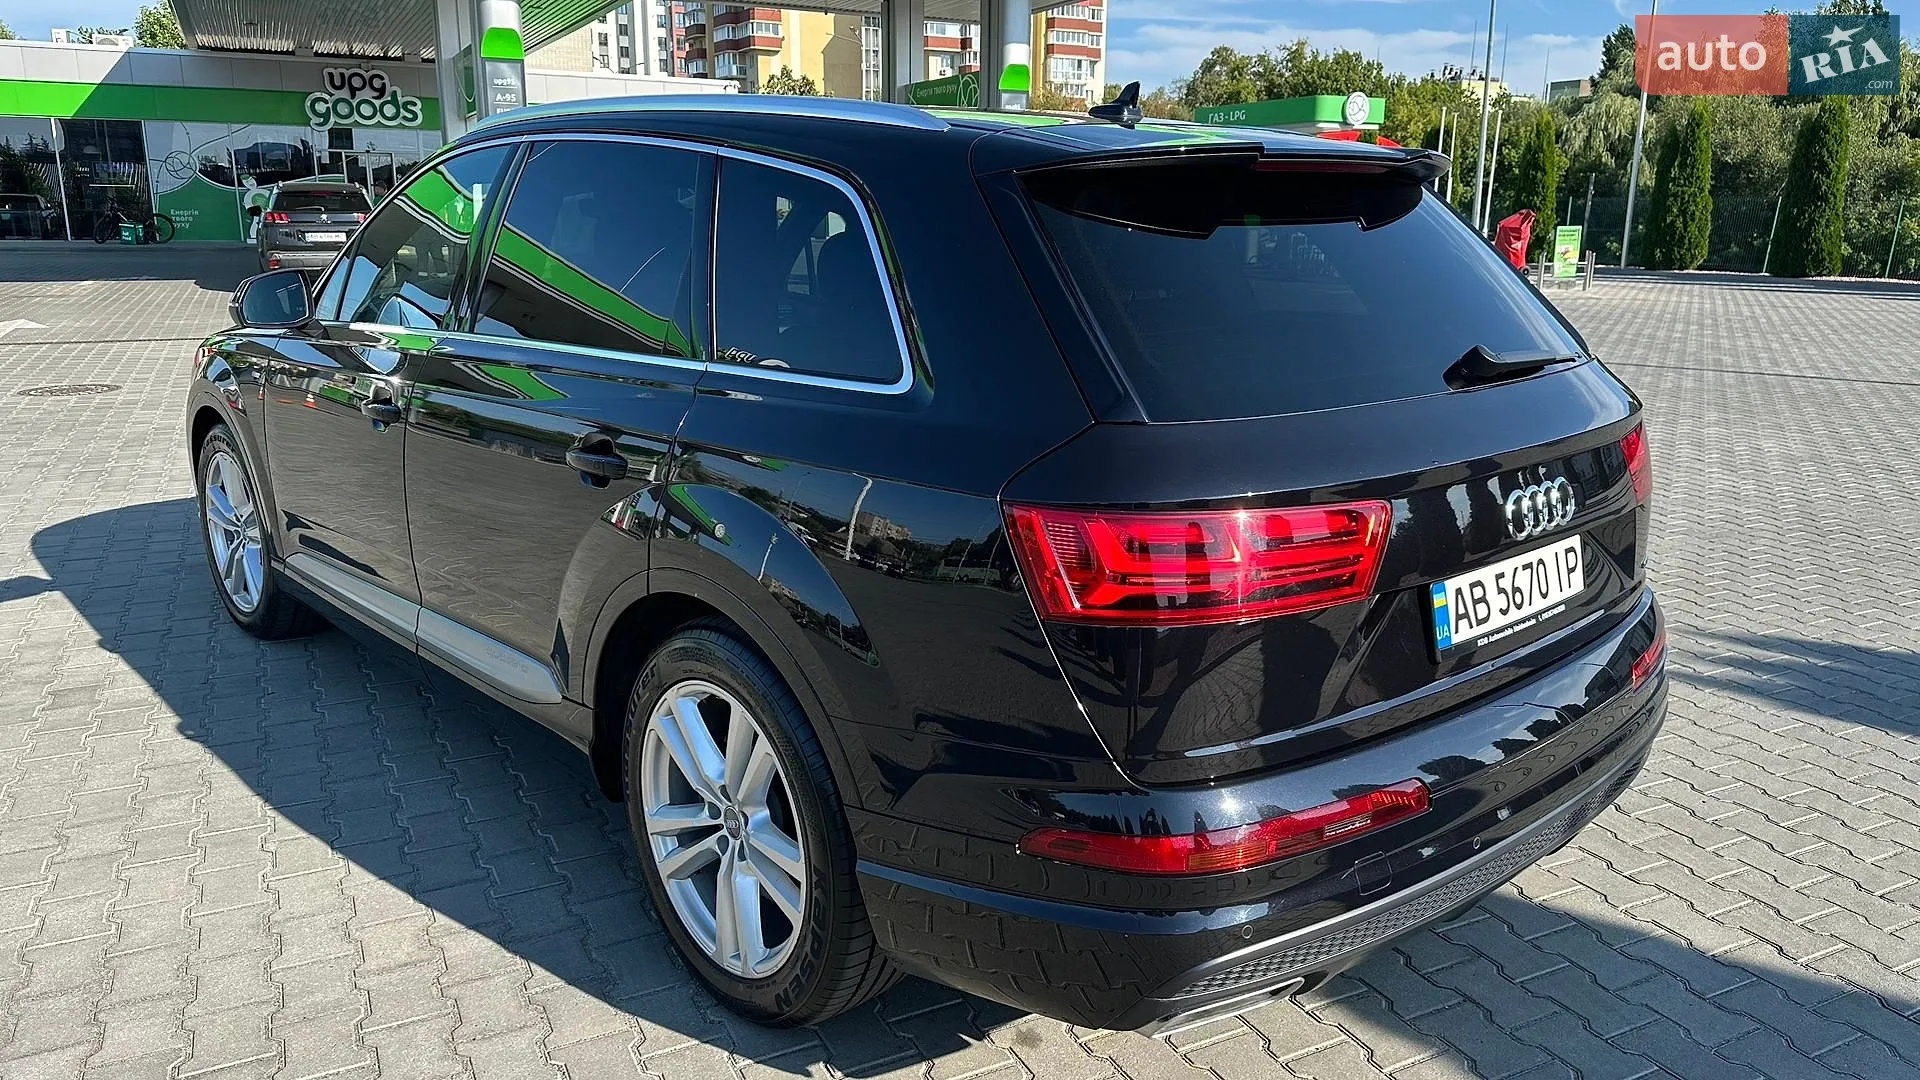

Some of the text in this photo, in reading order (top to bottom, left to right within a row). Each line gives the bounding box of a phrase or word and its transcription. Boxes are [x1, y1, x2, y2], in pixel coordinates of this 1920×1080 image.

[326, 71, 387, 100] upg
[309, 90, 419, 127] goods
[1230, 110, 1246, 121] LPG
[1454, 546, 1579, 635] AB 5670 IP
[1436, 625, 1450, 640] UA
